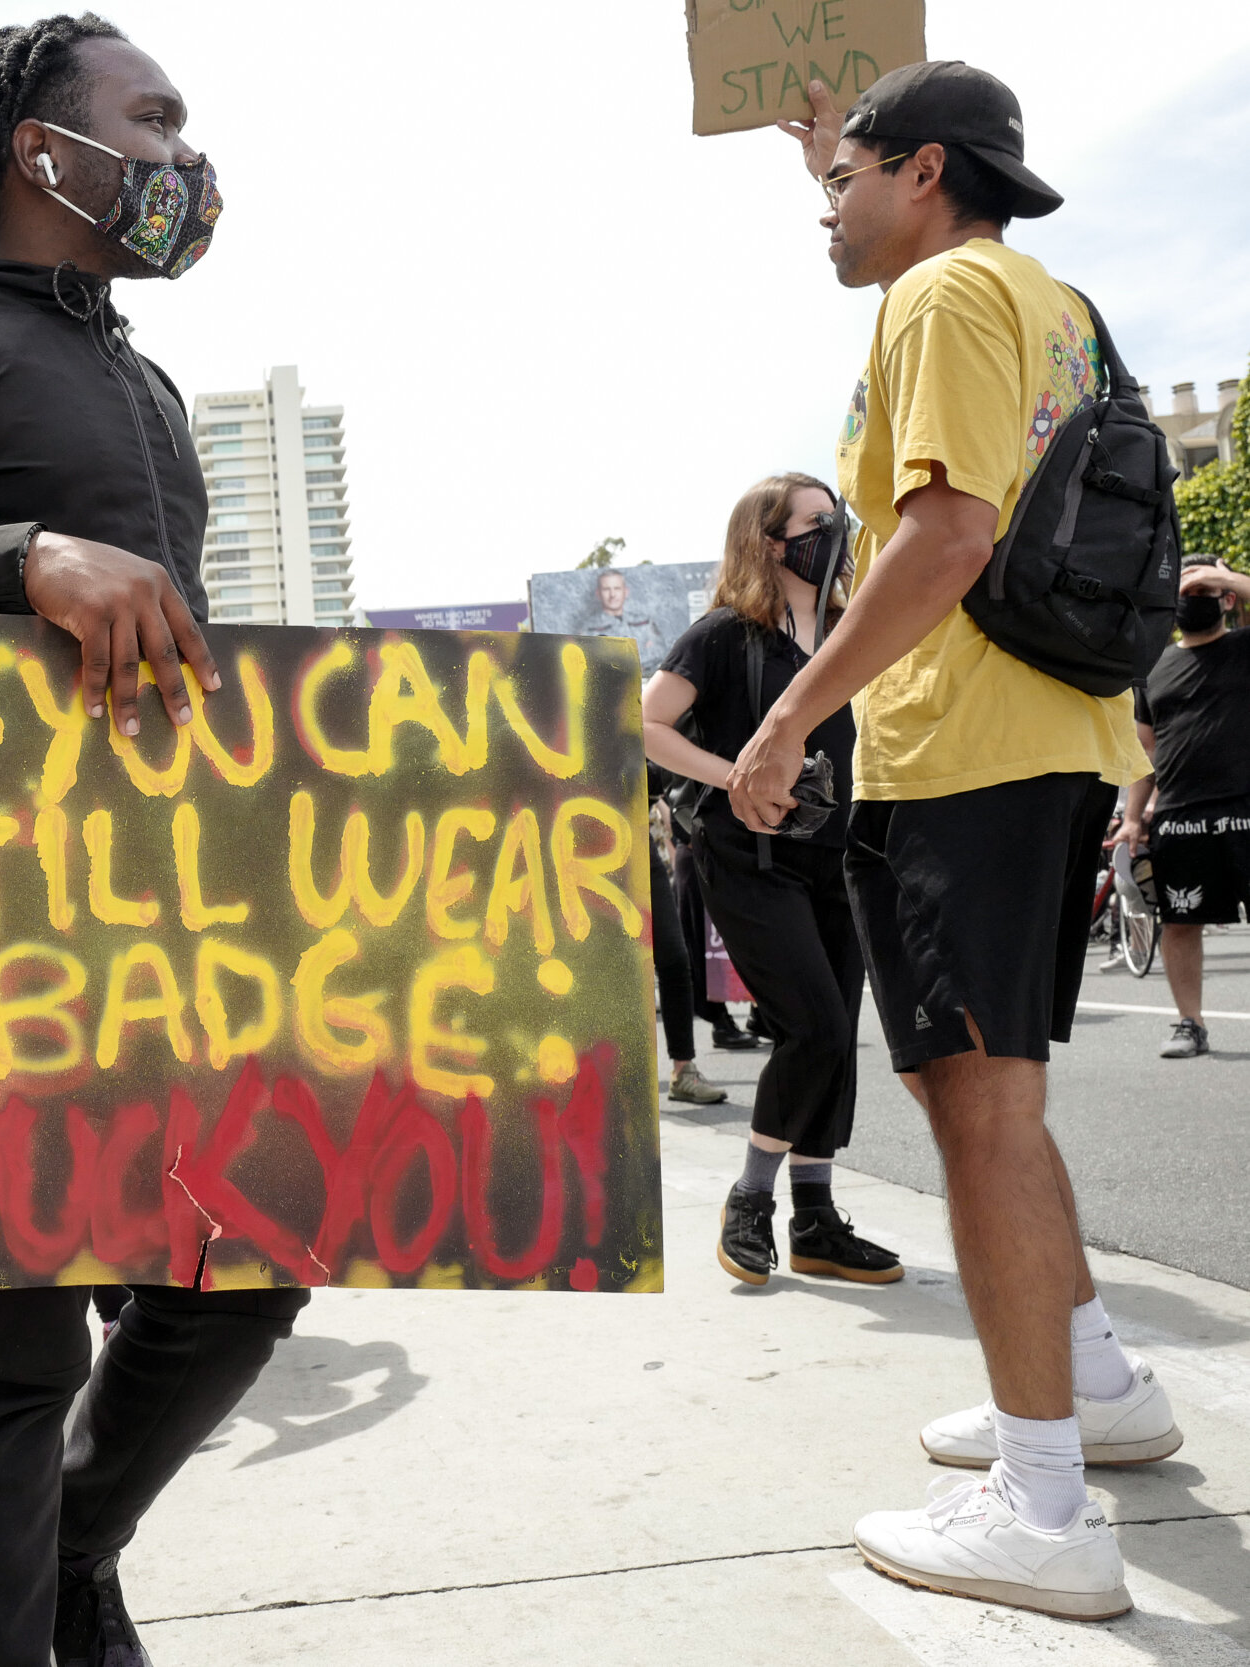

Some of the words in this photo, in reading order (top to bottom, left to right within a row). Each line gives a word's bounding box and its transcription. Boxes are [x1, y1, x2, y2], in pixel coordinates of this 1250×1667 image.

[772, 0, 846, 48] WE
[720, 50, 881, 115] STAND
[414, 612, 442, 621] WHERE
[465, 609, 493, 618] MEETS
[296, 642, 586, 781] CAN
[1158, 819, 1208, 836] Global
[288, 791, 645, 955] WEAR
